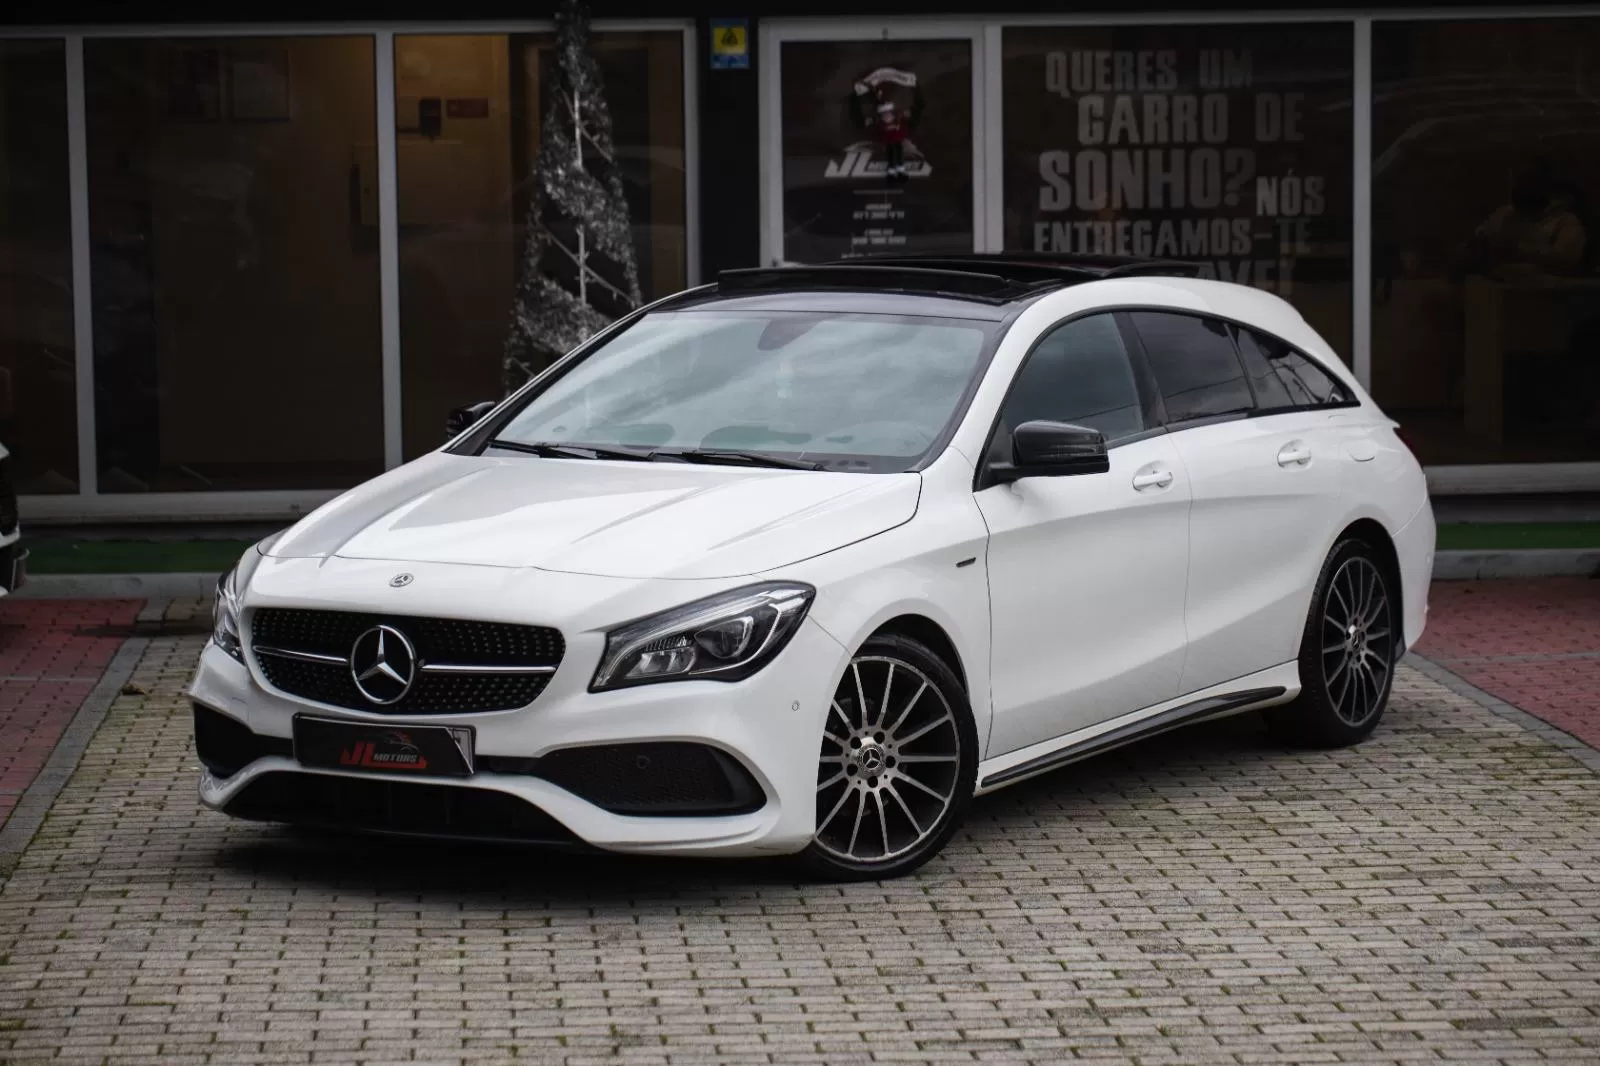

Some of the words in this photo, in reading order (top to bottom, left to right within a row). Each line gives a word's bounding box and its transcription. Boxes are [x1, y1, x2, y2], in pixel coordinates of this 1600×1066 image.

[1045, 50, 1179, 98] QUERES
[1199, 48, 1253, 89] UM
[1077, 94, 1229, 145] CARRO
[1255, 92, 1305, 142] DE
[1039, 148, 1257, 212] SONHO?
[1256, 167, 1326, 217] NÓS
[1033, 216, 1312, 257] ENTREGAMOS-TE
[373, 753, 418, 764] MOTORS
